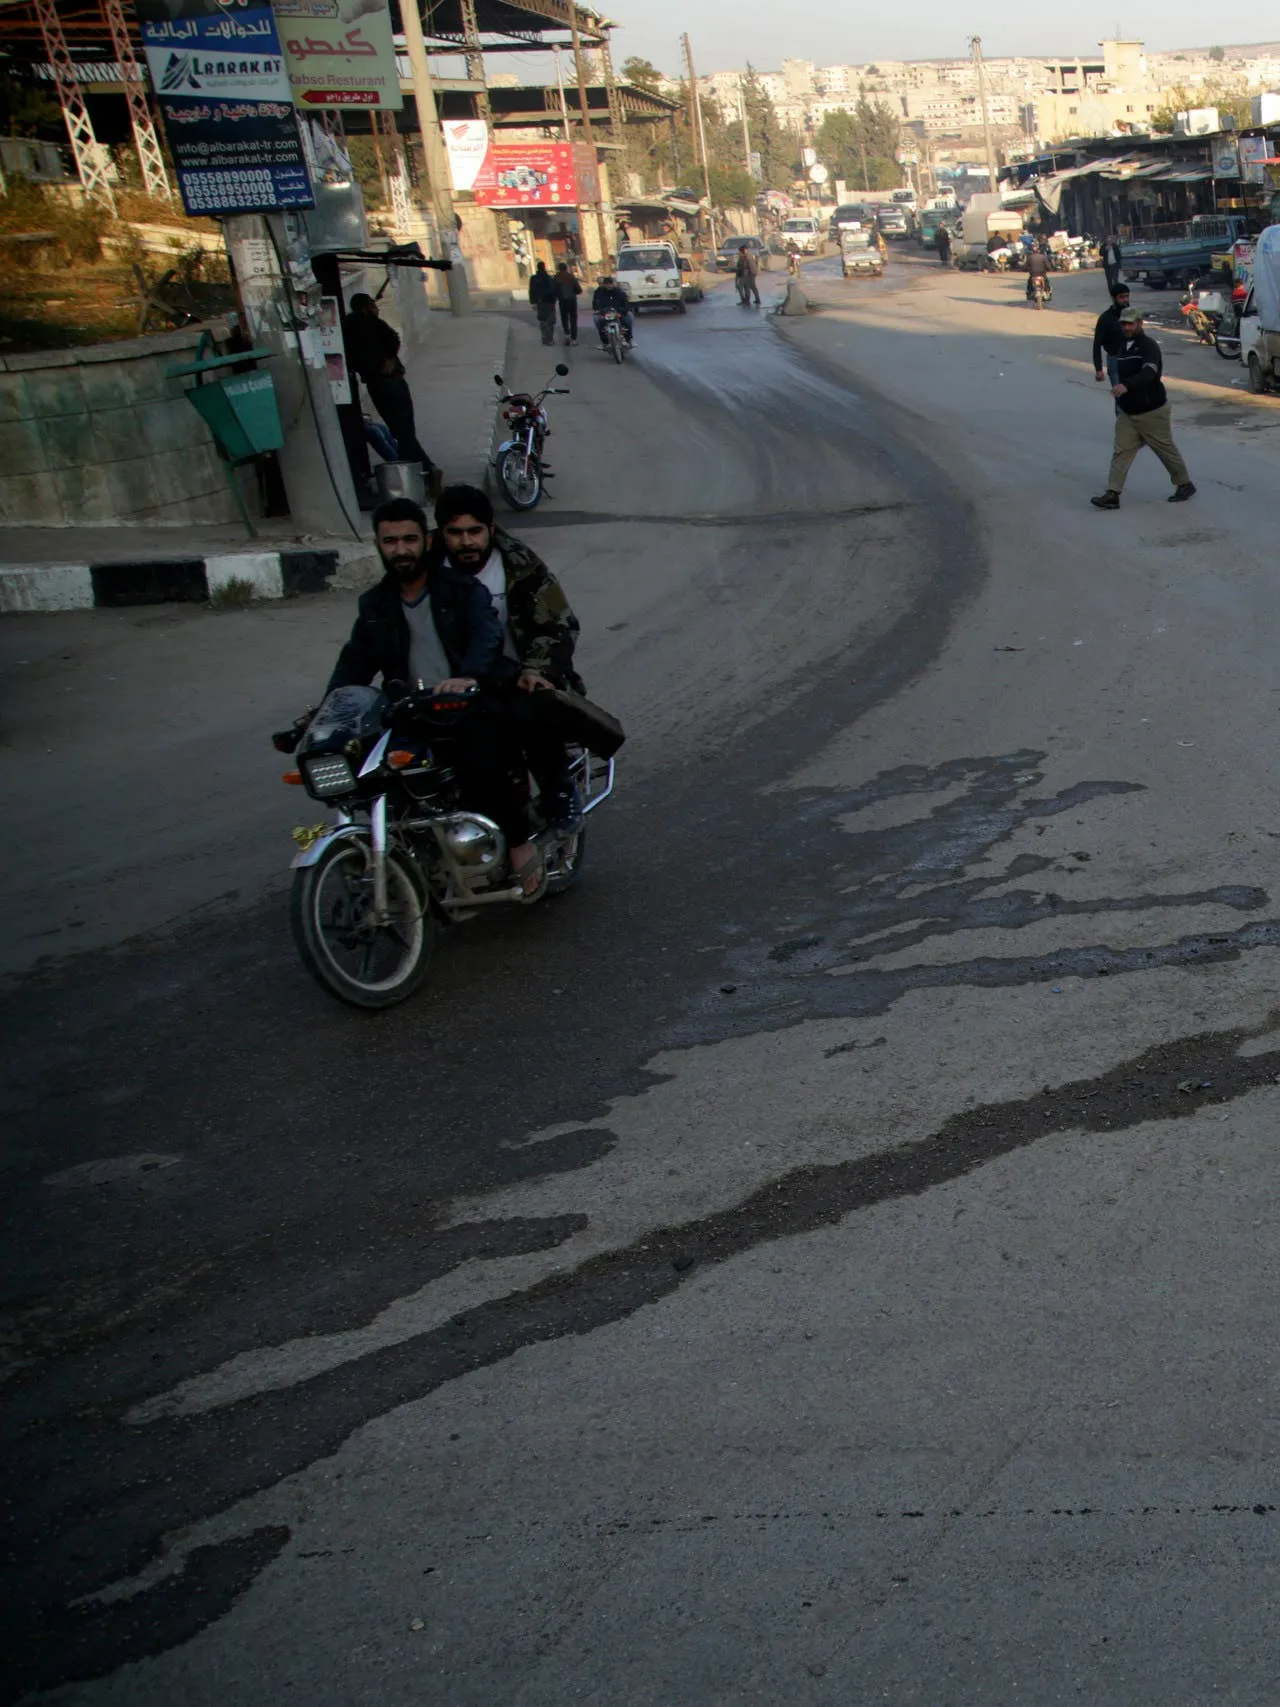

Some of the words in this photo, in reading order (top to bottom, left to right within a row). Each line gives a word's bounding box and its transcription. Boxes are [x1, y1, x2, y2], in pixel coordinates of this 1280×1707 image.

[146, 20, 198, 41] المالية
[327, 75, 385, 86] Resturant
[176, 139, 298, 155] info@albarakat-tr.com
[181, 152, 299, 167] www.albarakat-tr.com
[182, 169, 272, 185] 05558890000
[185, 182, 275, 198] 05558950000
[188, 194, 277, 210] 05388632528
